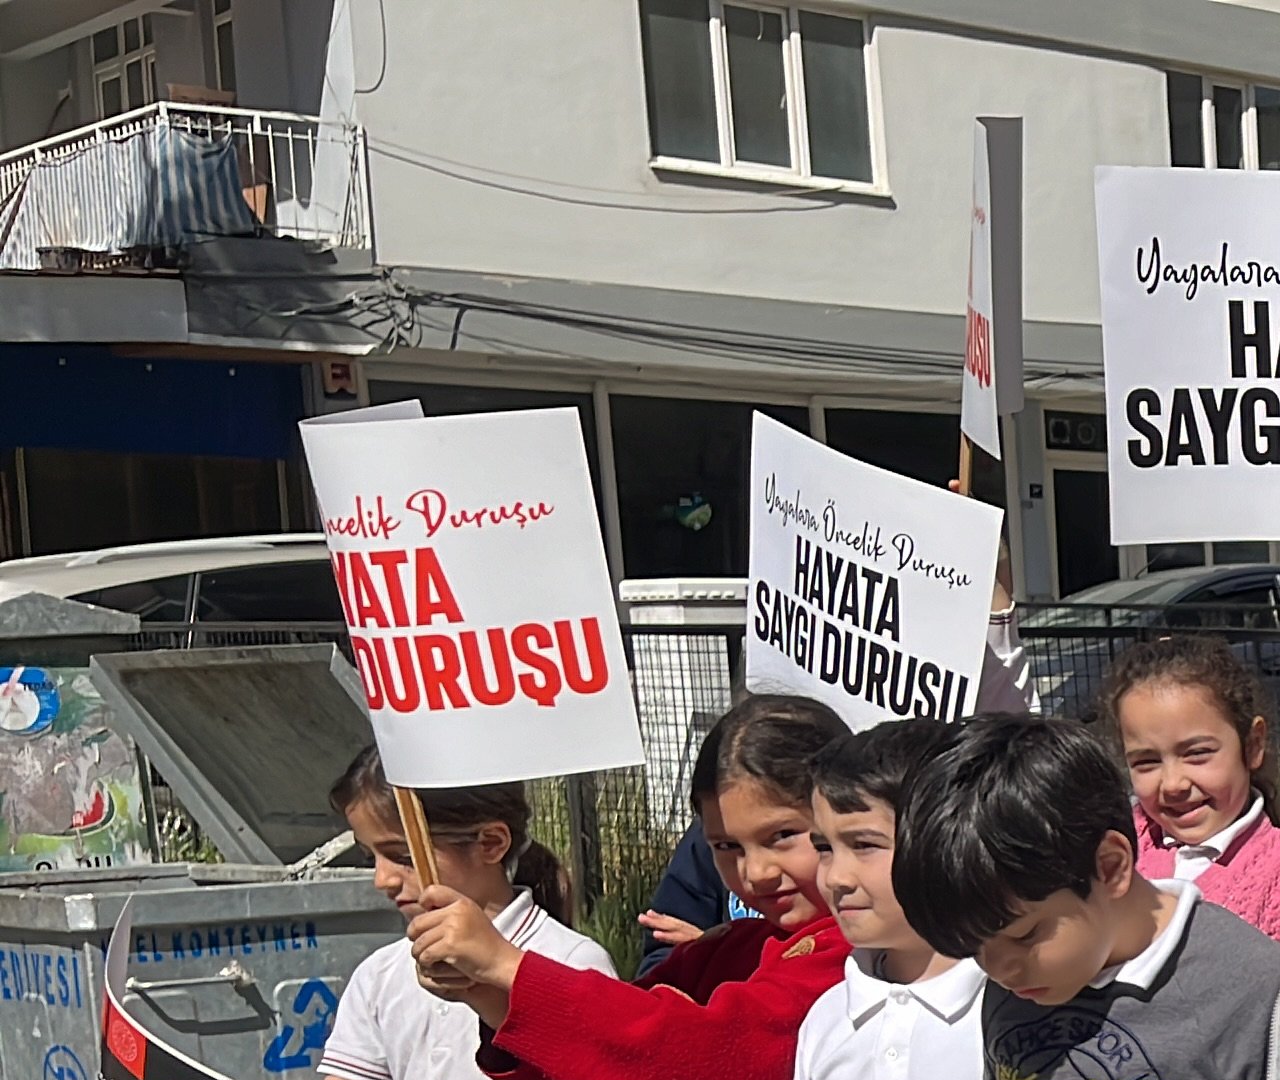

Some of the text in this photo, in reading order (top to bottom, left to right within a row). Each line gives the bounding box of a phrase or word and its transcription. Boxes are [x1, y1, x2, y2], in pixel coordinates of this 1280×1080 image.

[326, 488, 555, 540] ncelik Duruşu
[764, 472, 972, 590] Yayalara Öncelik Duruşu
[754, 579, 817, 674] SAYGI
[794, 534, 901, 644] HAYATA
[351, 615, 610, 714] DURUŞU
